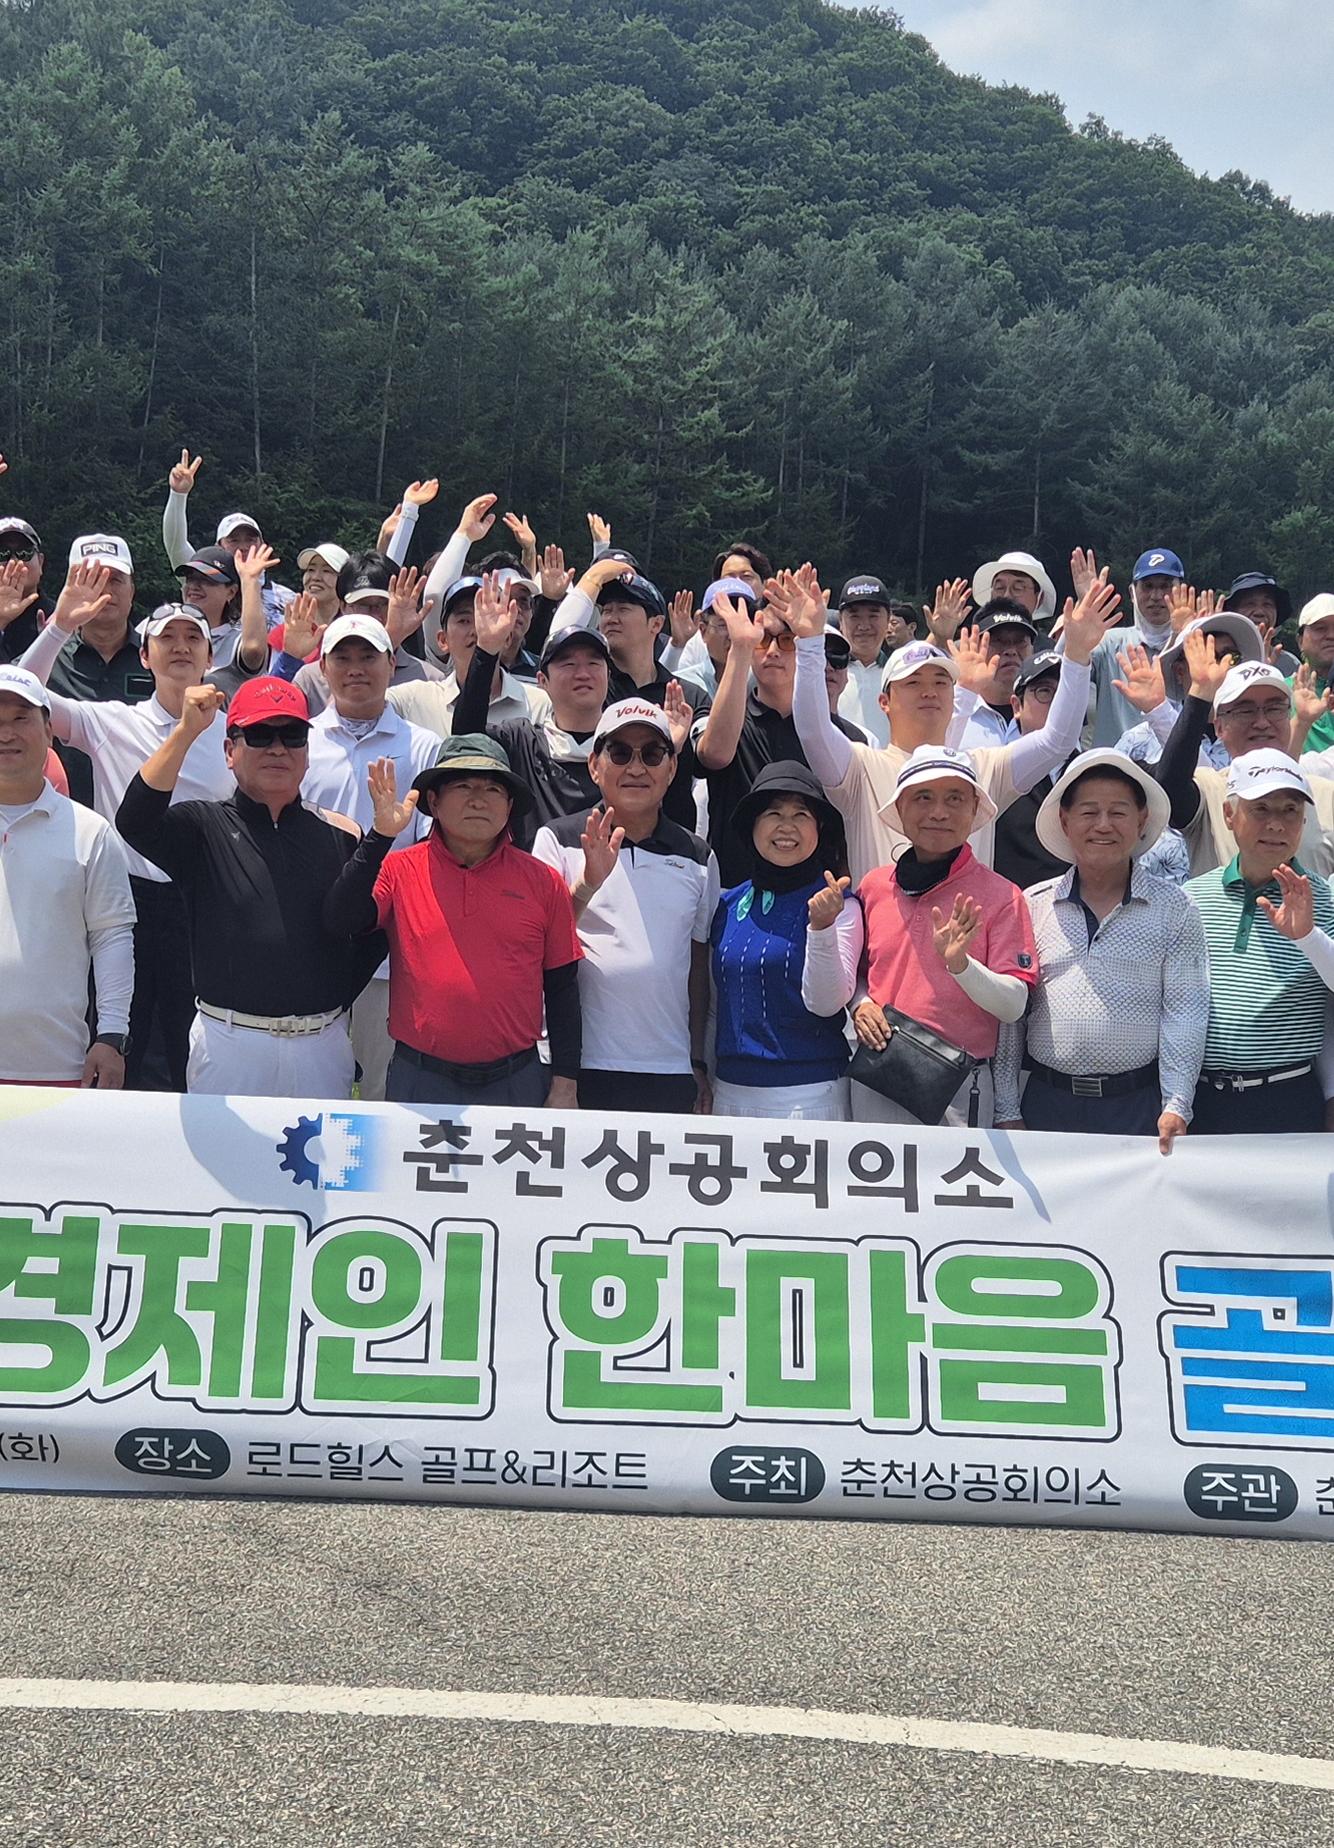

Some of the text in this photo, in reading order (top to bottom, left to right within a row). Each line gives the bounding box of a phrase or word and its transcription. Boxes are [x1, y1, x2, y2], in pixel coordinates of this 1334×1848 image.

[83, 543, 116, 556] PING
[992, 613, 1023, 623] Volvik
[615, 705, 658, 719] Volvik
[402, 1118, 1015, 1213] 춘천상공회의소
[543, 1230, 1115, 1434] 한마음
[132, 1435, 649, 1490] 장소 로드힐스 골프&리조트
[729, 1454, 1122, 1507] 주최 춘천상공회의소
[1200, 1470, 1282, 1515] 주관
